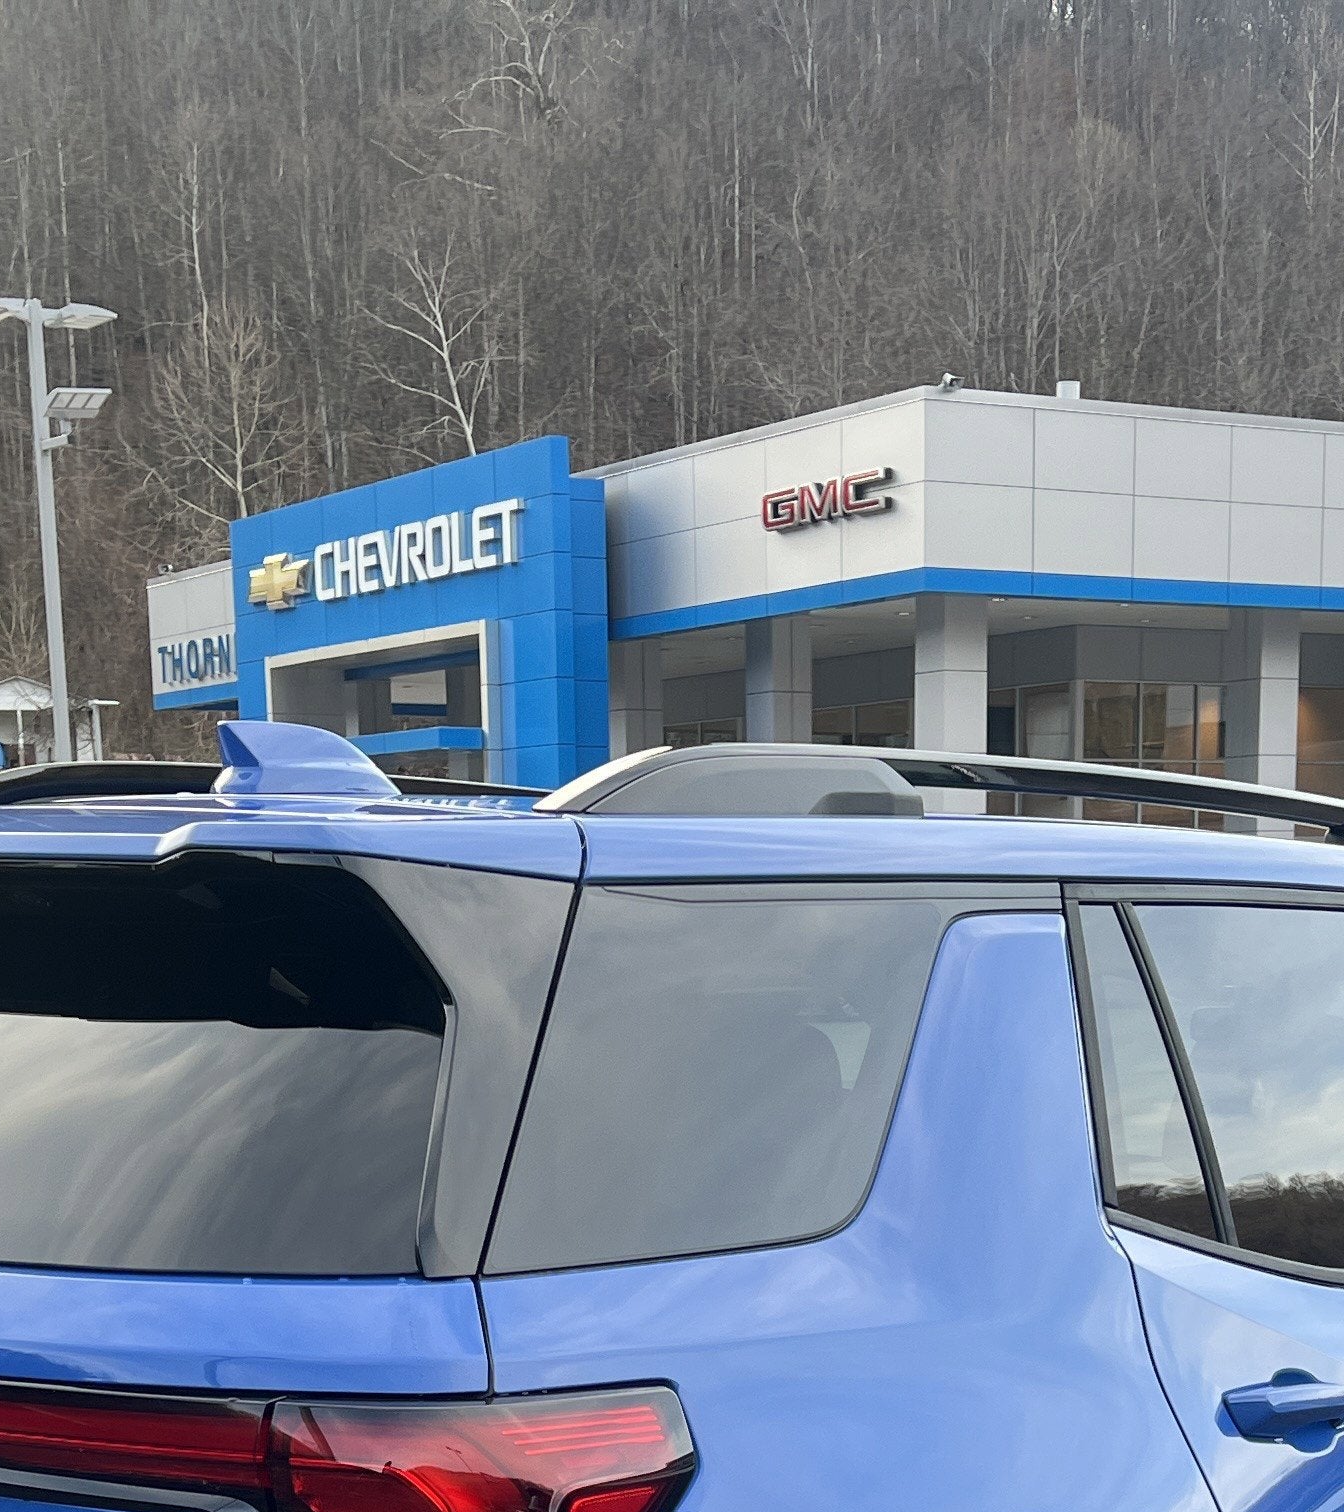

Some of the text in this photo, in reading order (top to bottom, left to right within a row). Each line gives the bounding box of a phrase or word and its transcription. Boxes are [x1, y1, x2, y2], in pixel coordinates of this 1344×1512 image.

[761, 467, 895, 533] GMC
[313, 498, 524, 602] CHEVROLET
[158, 634, 236, 683] THORN
